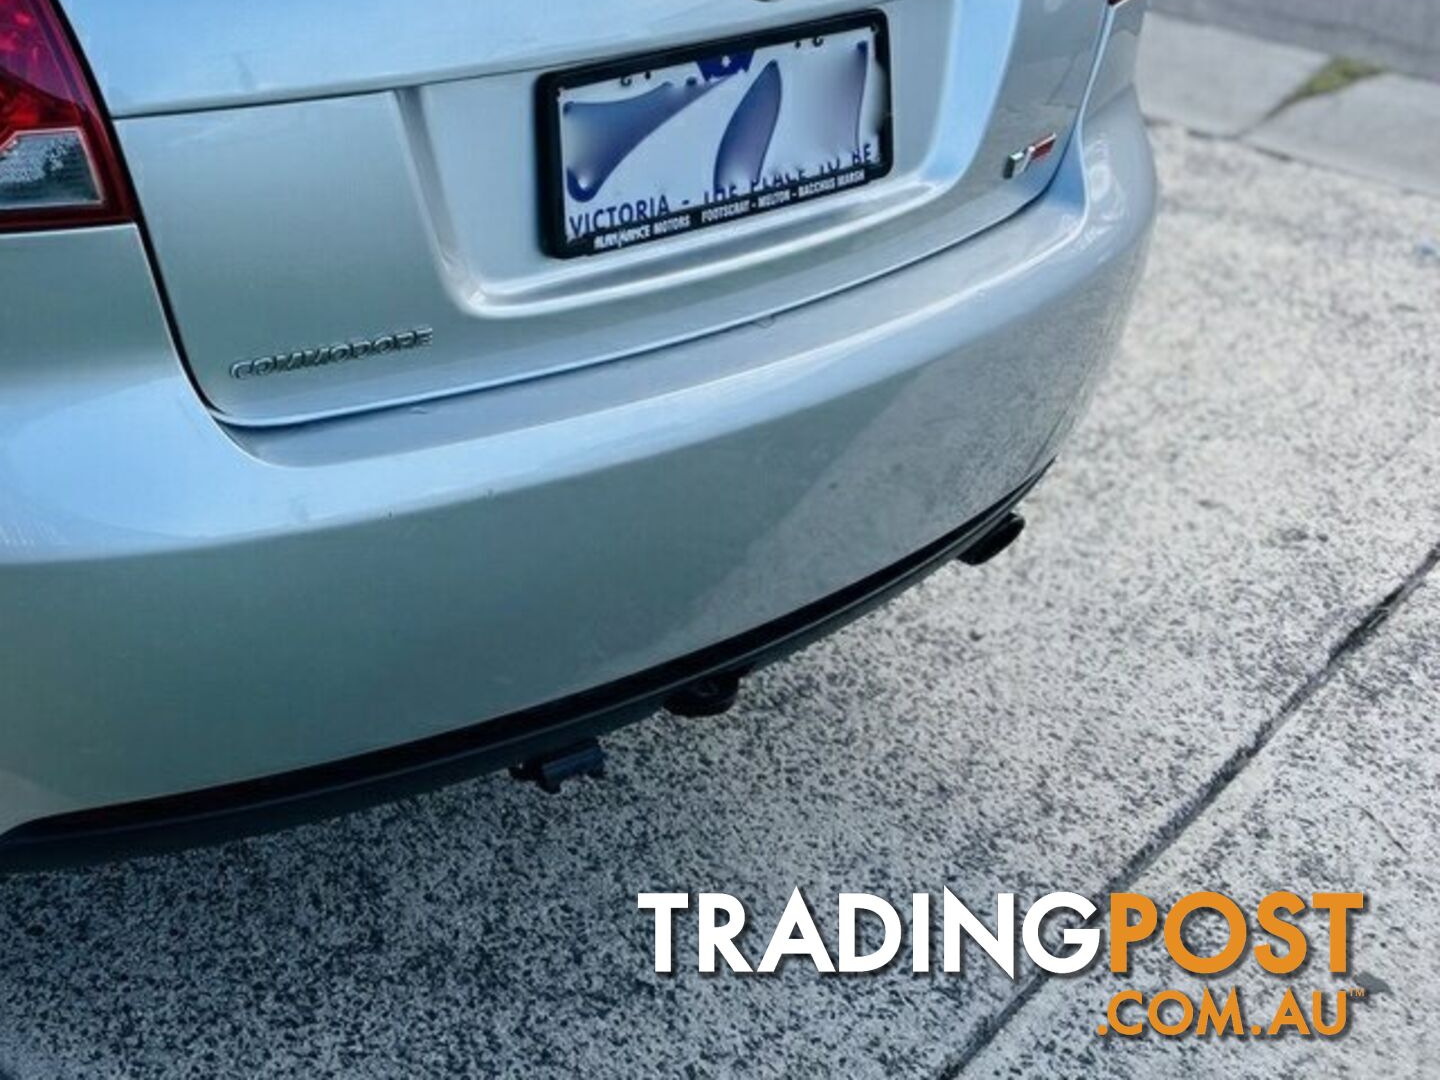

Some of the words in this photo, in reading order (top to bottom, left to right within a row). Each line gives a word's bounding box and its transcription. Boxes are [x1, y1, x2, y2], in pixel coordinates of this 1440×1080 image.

[569, 194, 671, 238] VICTORIA
[654, 214, 691, 236] MOTORS
[701, 199, 750, 223] FOOTSCRAY
[798, 177, 836, 199] BACCHUS
[837, 169, 865, 187] MARSH
[229, 327, 433, 380] COMMODORE
